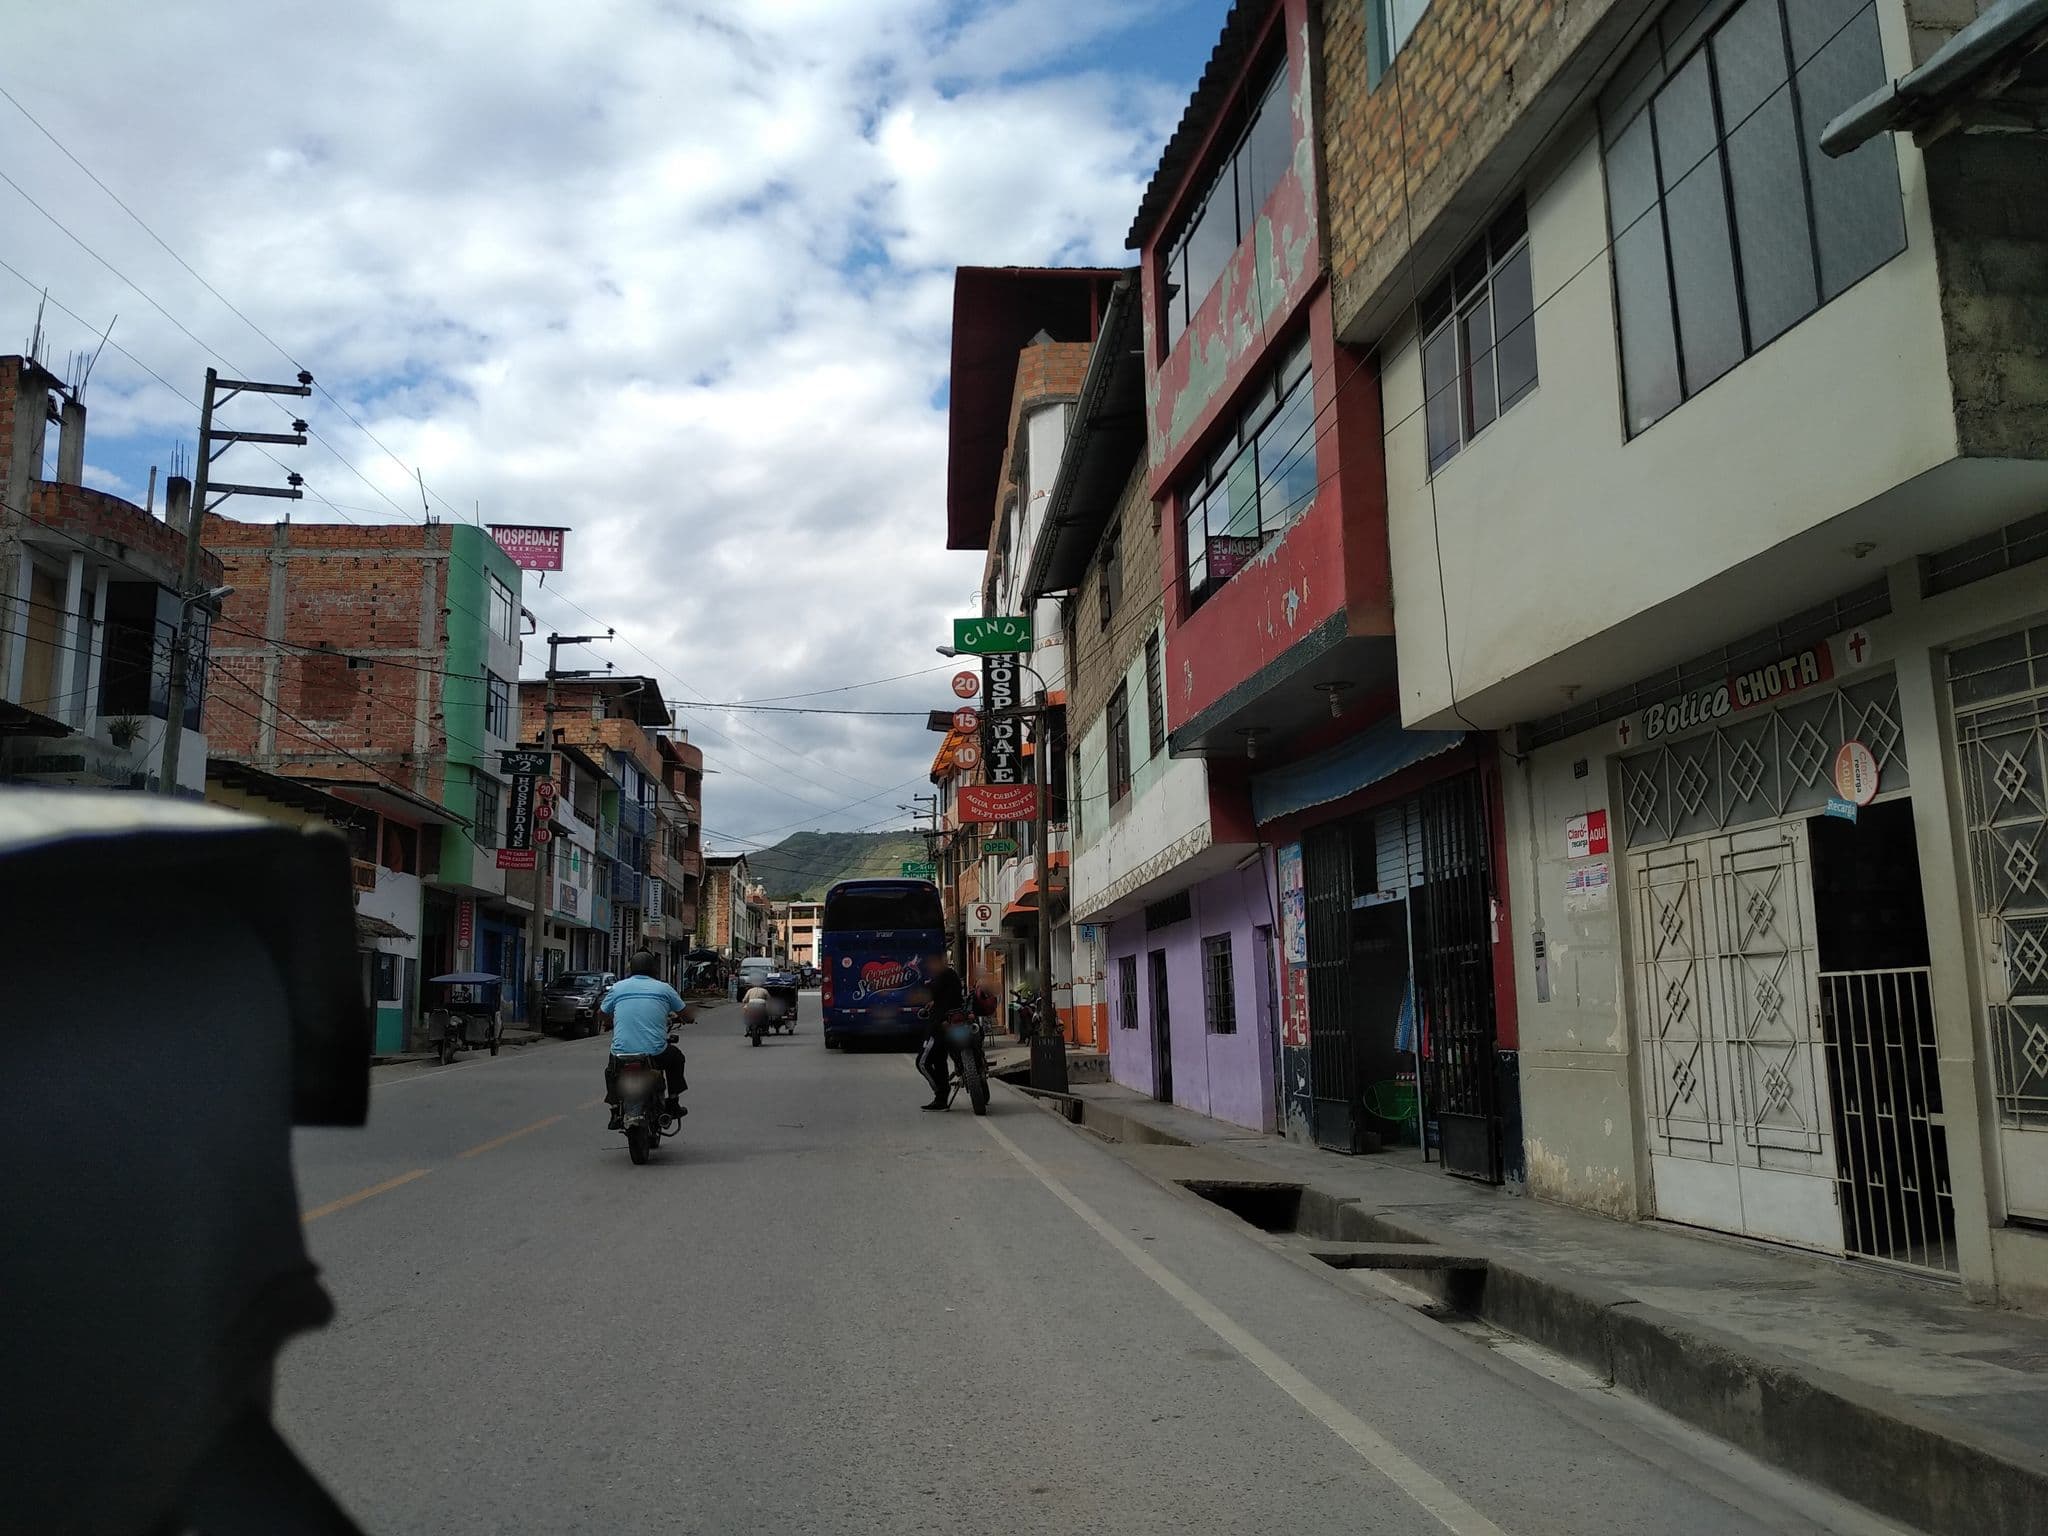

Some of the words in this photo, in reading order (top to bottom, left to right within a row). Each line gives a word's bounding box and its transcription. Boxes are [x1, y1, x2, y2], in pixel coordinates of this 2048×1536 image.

[495, 527, 560, 546] HOSPEDAJE
[964, 620, 1030, 645] CINDY
[954, 677, 977, 691] 20
[1642, 684, 1732, 740] Botica
[1735, 650, 1819, 706] CHOTA
[955, 712, 977, 727] 15
[508, 753, 545, 765] ARIES
[955, 748, 977, 763] 10
[519, 760, 531, 772] 2
[1854, 759, 1862, 793] recarga
[541, 786, 551, 796] 20
[980, 789, 992, 798] TV
[993, 788, 1021, 800] CABLE
[966, 794, 988, 809] AGUA
[992, 790, 1035, 810] CALIENTE
[512, 777, 530, 848] HOSPEDAJE
[540, 807, 549, 816] 15
[994, 805, 1036, 820] COCHERA
[1827, 799, 1856, 818] Recarga
[537, 831, 547, 840] 10
[1568, 826, 1585, 841] Claro
[983, 841, 1011, 854] OPEN
[852, 969, 912, 1001] Serrano
